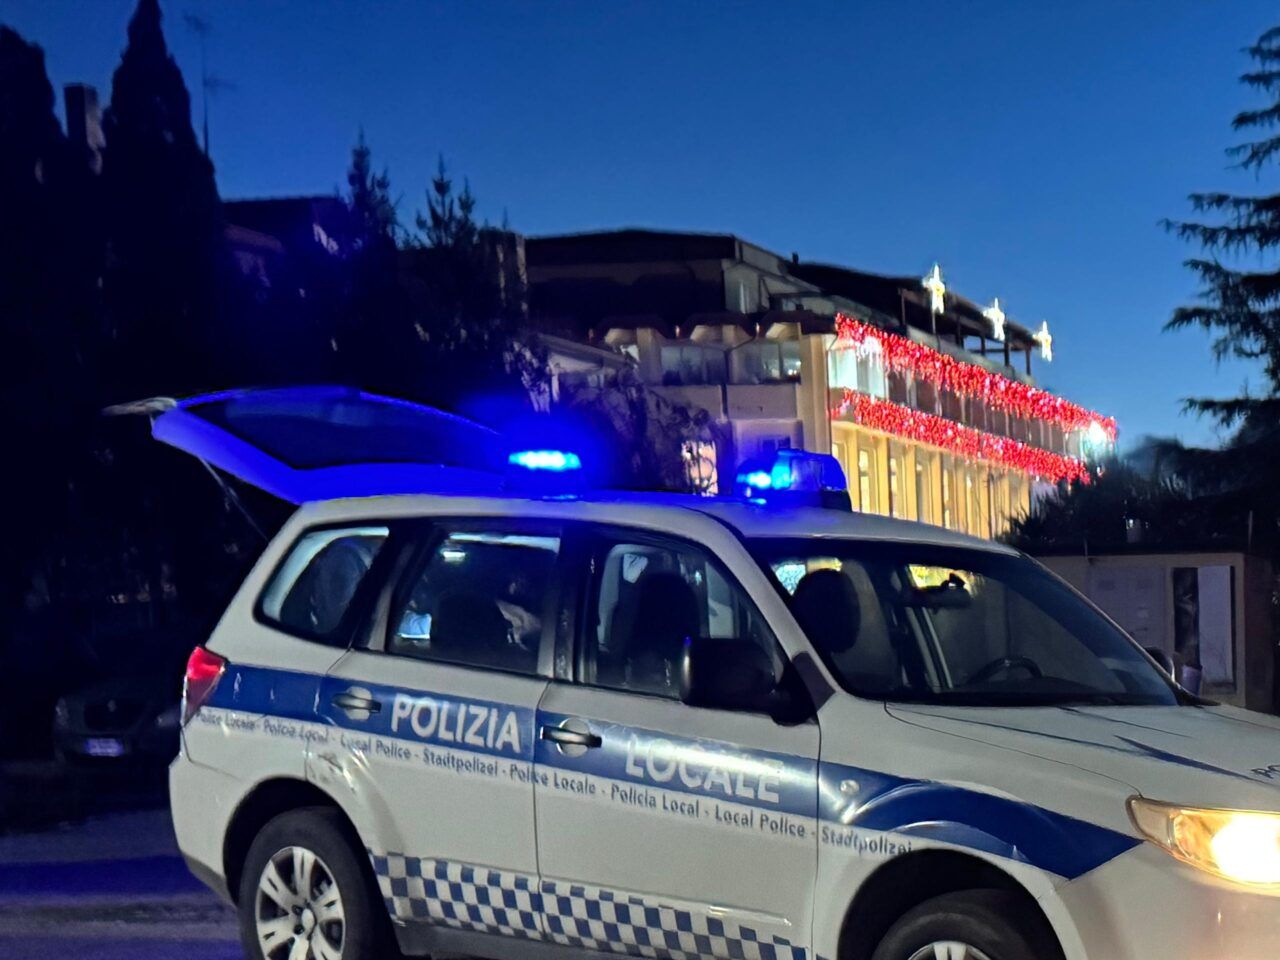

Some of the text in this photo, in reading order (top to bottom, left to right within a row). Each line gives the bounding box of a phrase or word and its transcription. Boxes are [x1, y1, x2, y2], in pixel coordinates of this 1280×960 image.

[376, 739, 412, 760] Police
[422, 745, 498, 777] Stadtpolizei
[510, 763, 549, 787] Police
[553, 772, 596, 795] Locale
[611, 783, 657, 809] Policia
[662, 793, 700, 819] Local
[715, 803, 754, 829] Local
[760, 813, 806, 838] Police
[822, 825, 912, 856] Stadtpolizei
[389, 692, 783, 804] POLIZIA LOCALE
